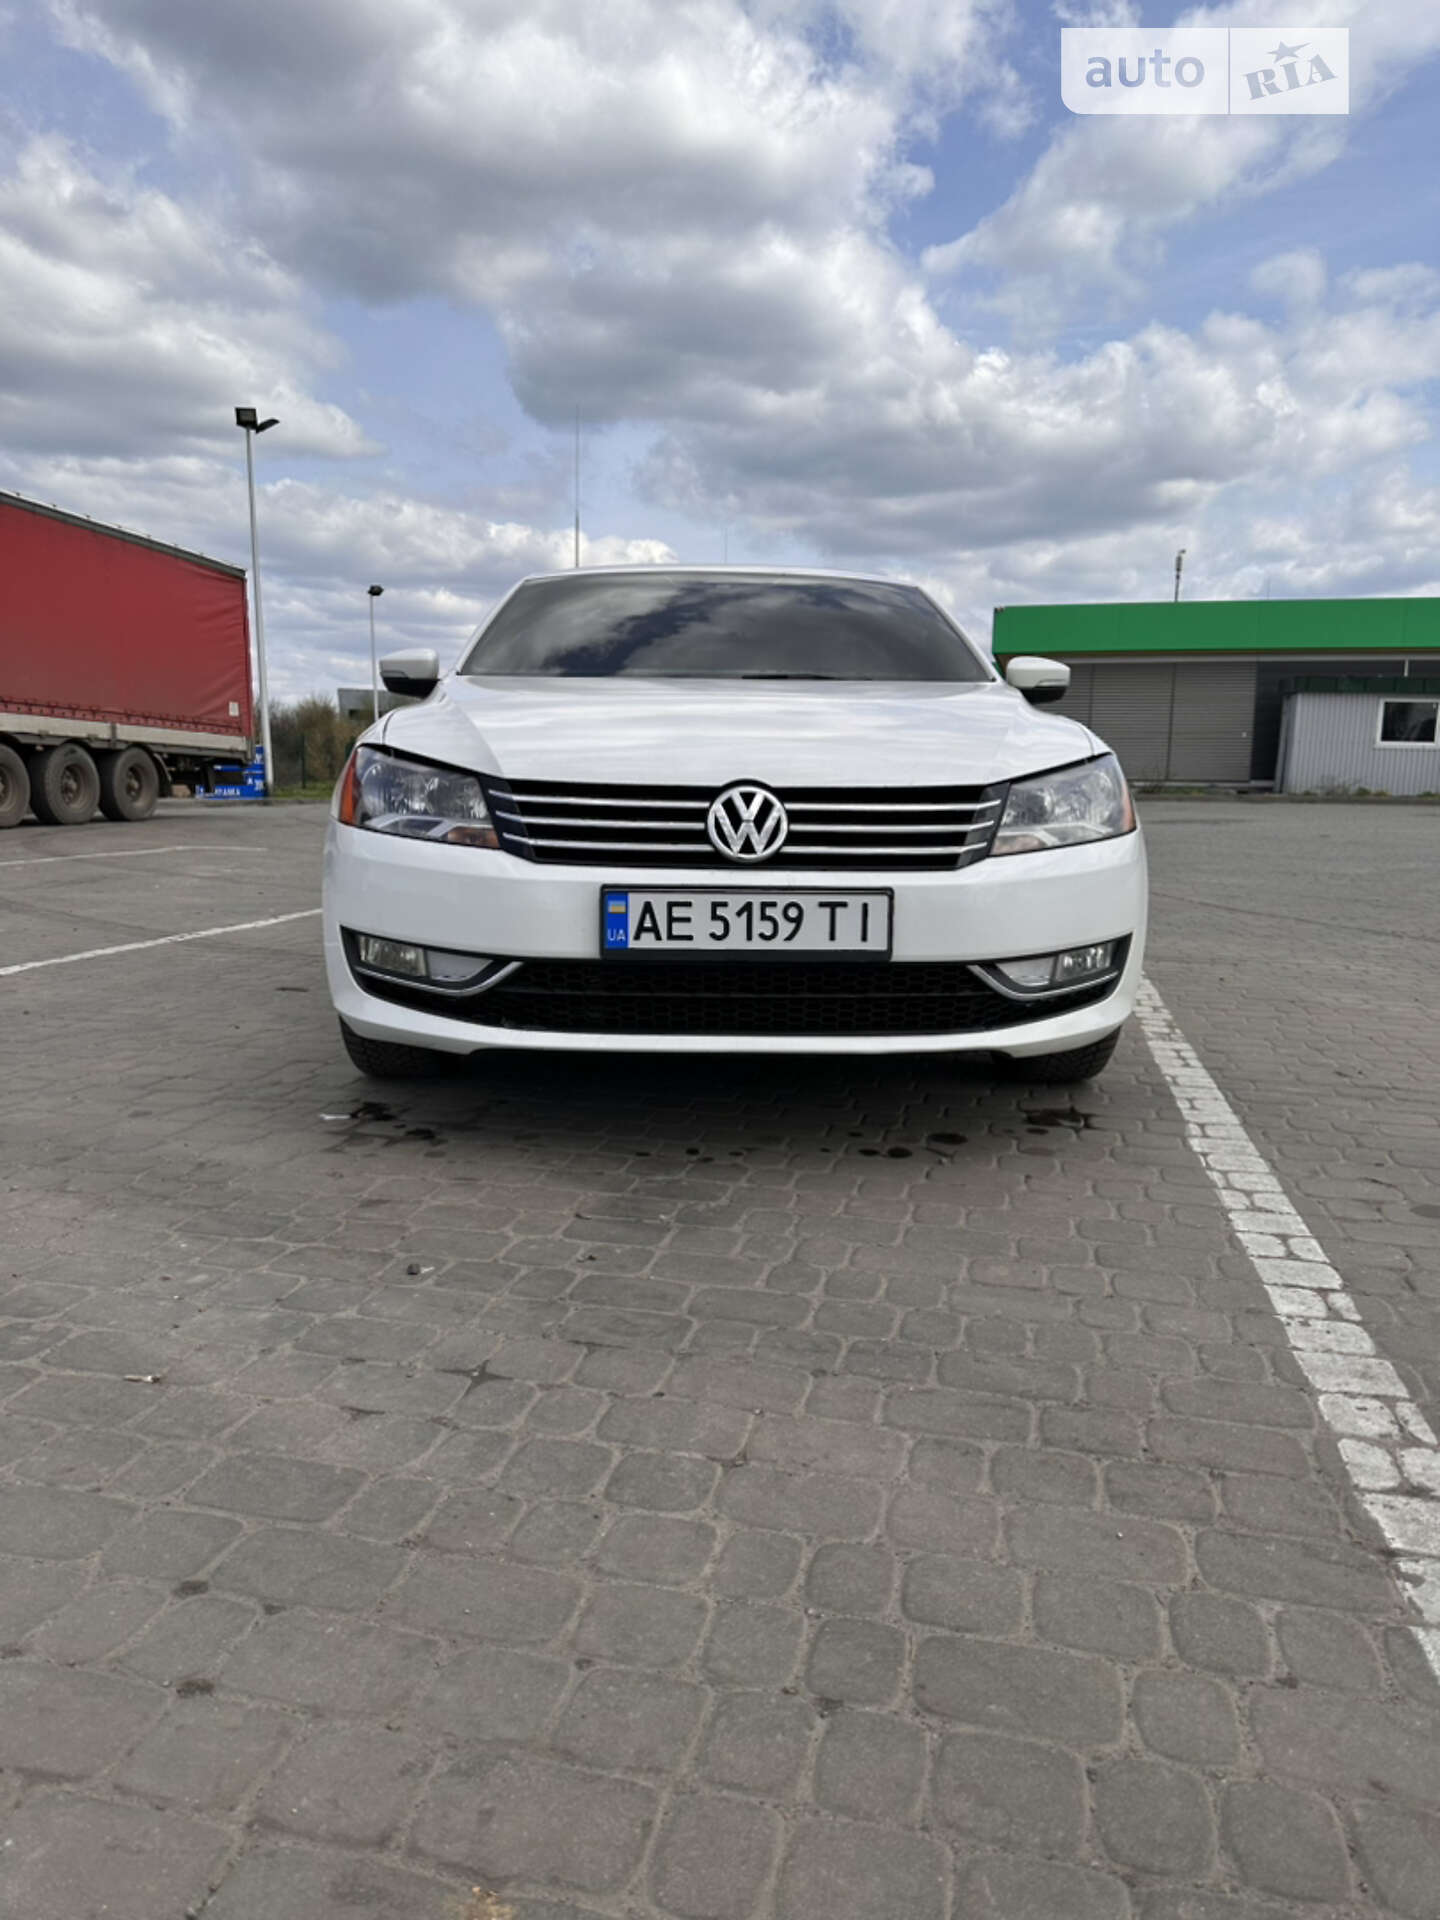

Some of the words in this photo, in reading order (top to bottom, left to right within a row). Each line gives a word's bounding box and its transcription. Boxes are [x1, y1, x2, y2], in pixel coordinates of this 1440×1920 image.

[633, 901, 694, 941] AE
[709, 901, 804, 942] 5159
[608, 929, 626, 941] UA
